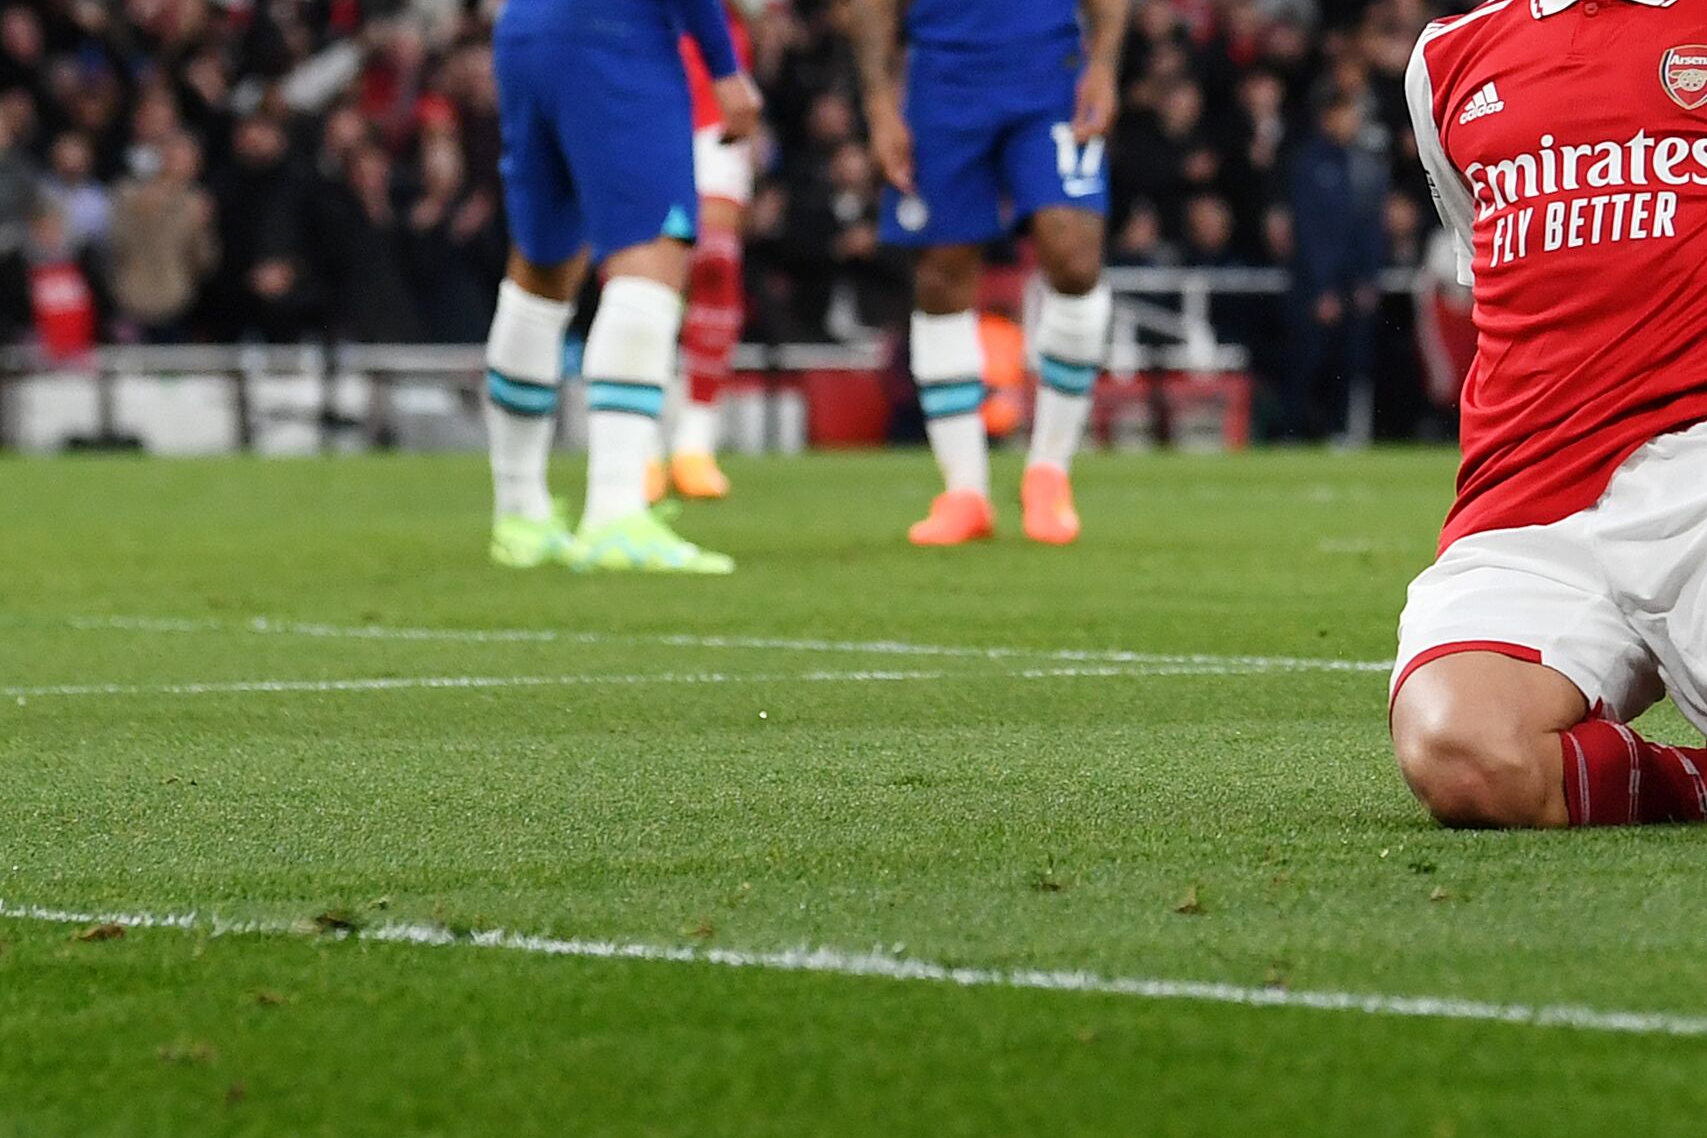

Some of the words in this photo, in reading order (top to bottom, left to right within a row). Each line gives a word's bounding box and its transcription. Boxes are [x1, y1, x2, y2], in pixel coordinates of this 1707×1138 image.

[1459, 100, 1505, 125] adidas
[1490, 208, 1532, 268] FLY
[1543, 191, 1677, 253] BETTER
